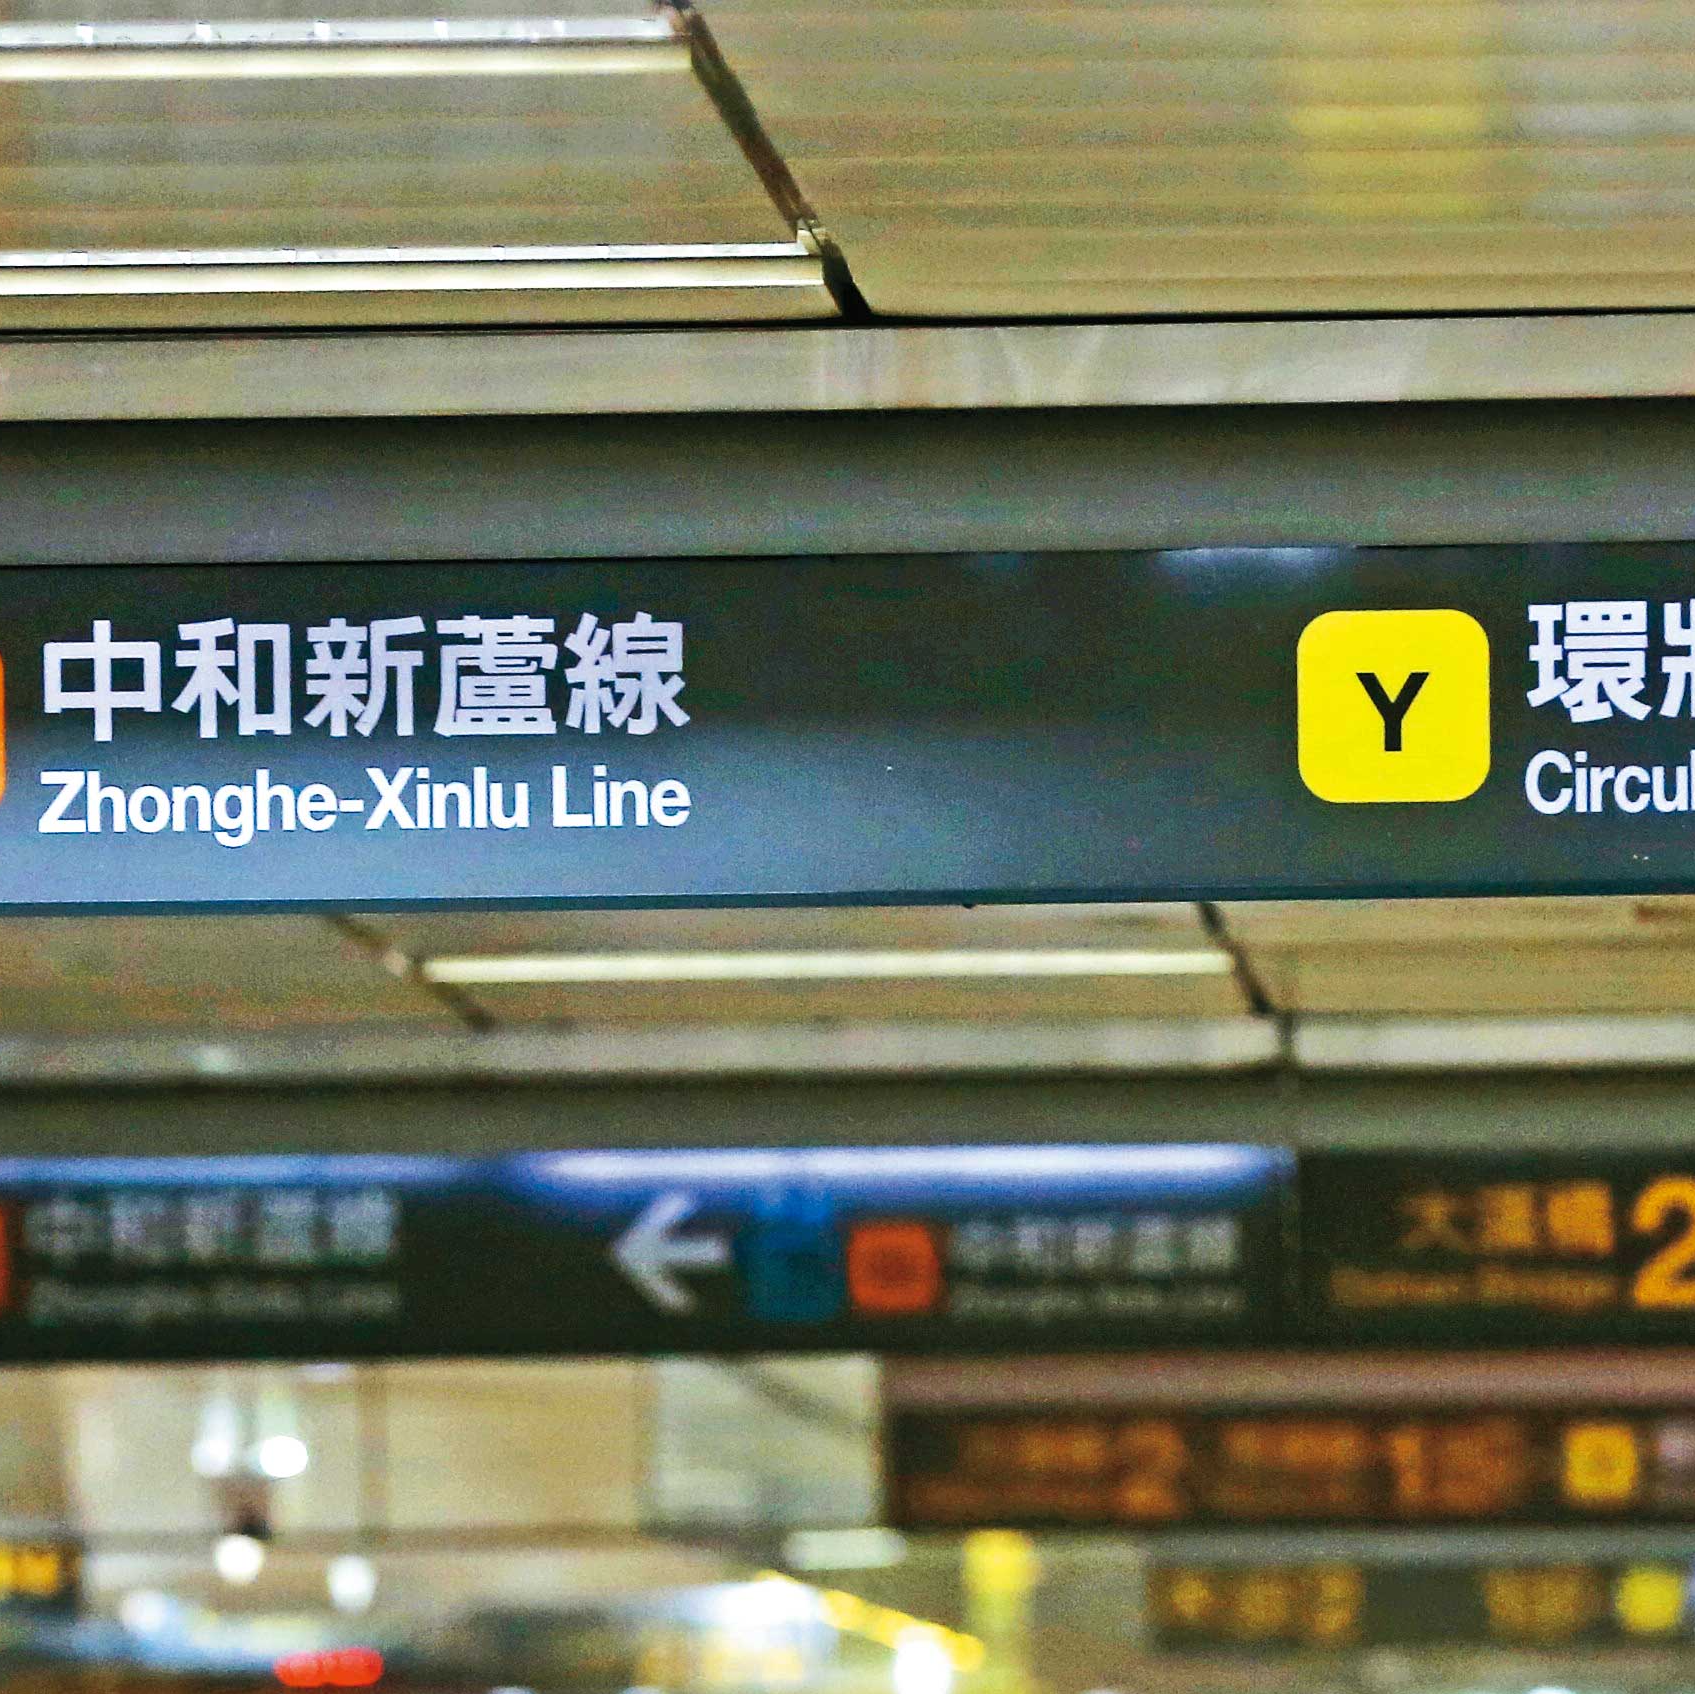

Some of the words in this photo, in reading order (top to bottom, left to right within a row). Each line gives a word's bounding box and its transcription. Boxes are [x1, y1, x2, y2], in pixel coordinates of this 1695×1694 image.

[41, 613, 691, 744] 中和新蘆線
[1356, 671, 1431, 754] Y
[38, 766, 532, 850] Zhonghe-Xinlu
[550, 764, 692, 830] Line
